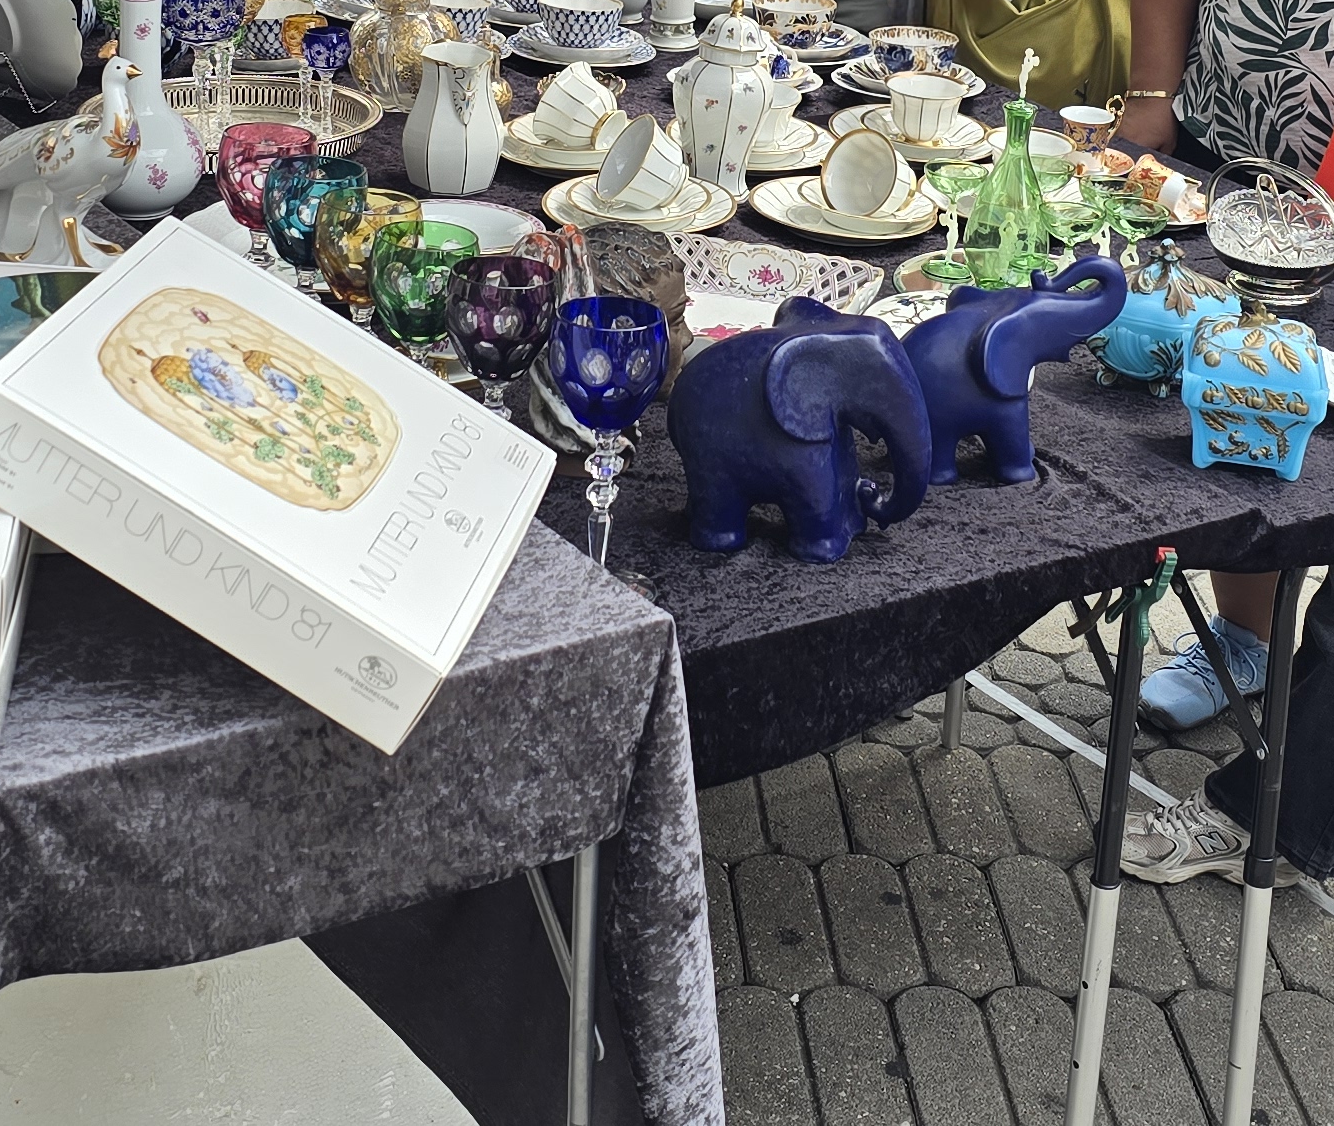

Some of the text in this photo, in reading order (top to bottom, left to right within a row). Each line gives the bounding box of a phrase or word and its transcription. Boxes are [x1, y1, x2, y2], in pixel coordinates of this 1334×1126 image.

[124, 498, 204, 566] UND
[205, 552, 290, 621] KIND
[349, 511, 426, 600] MUTTER
[399, 471, 448, 520] UND
[425, 432, 472, 481] KIND
